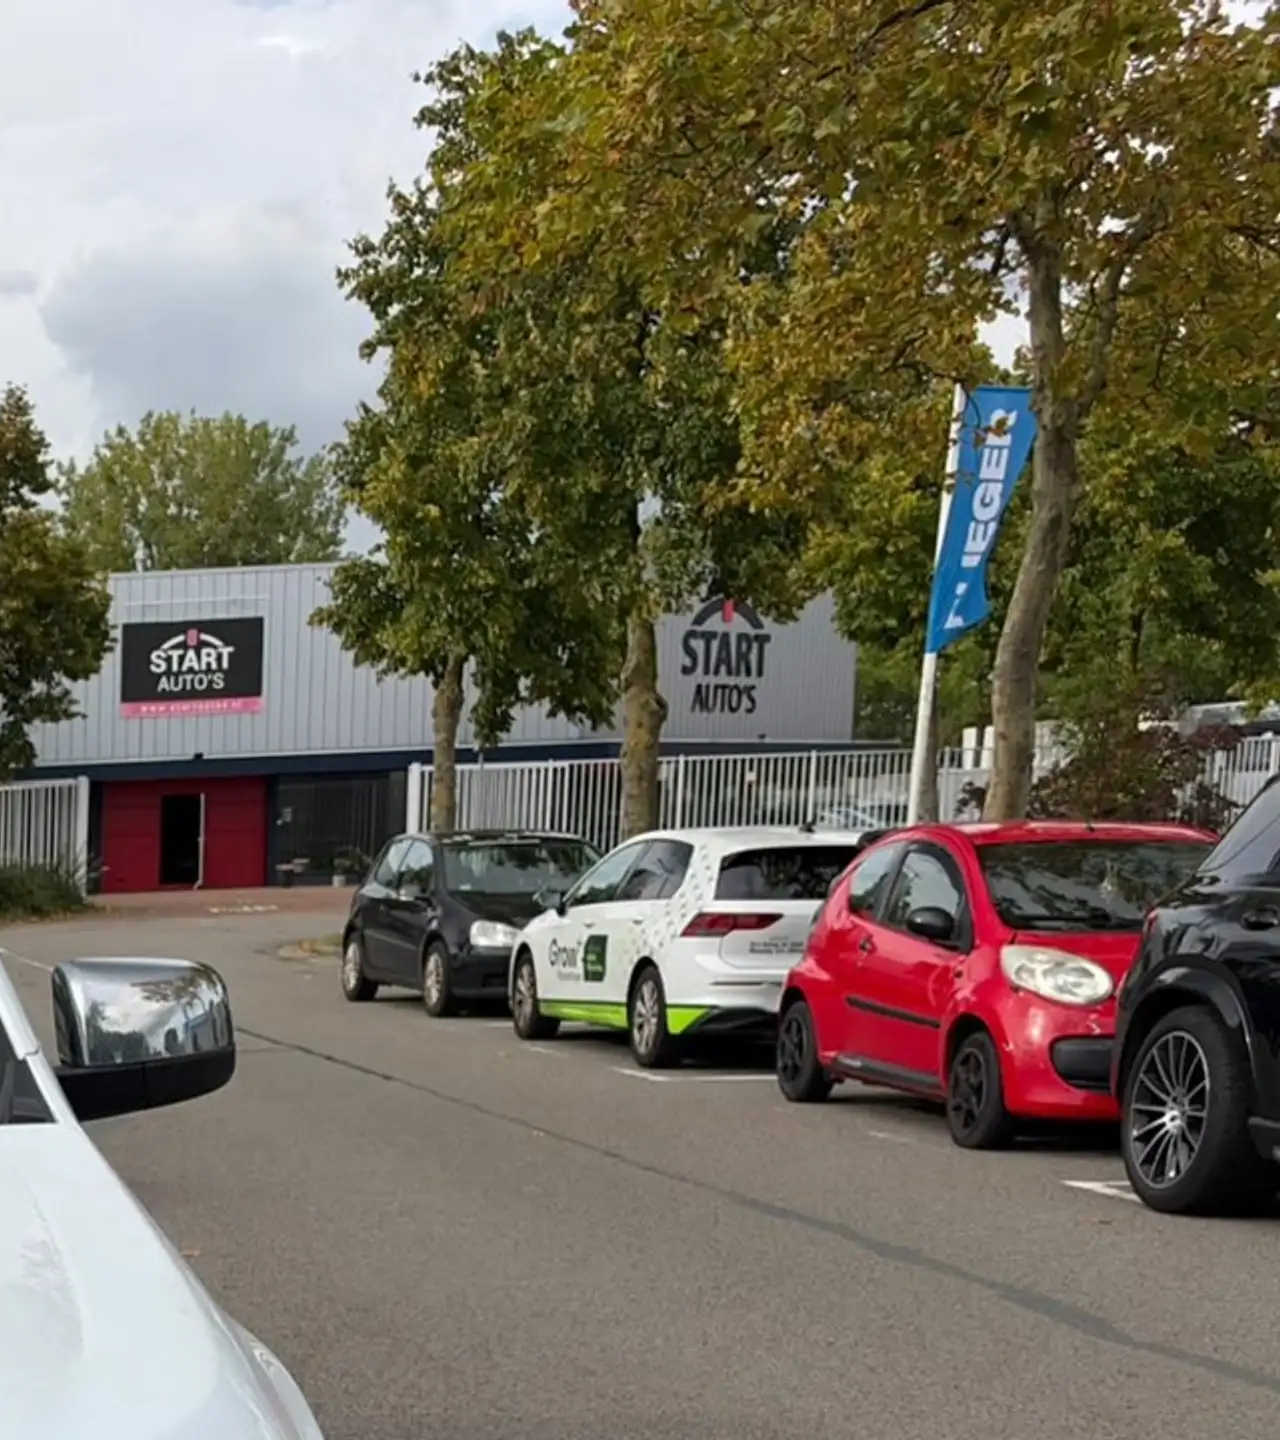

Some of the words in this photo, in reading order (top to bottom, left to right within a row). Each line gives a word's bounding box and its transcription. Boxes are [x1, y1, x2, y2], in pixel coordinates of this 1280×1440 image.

[149, 646, 235, 673] START
[681, 629, 771, 678] START
[156, 672, 225, 693] AUTO'S
[691, 683, 757, 714] AUTO'S
